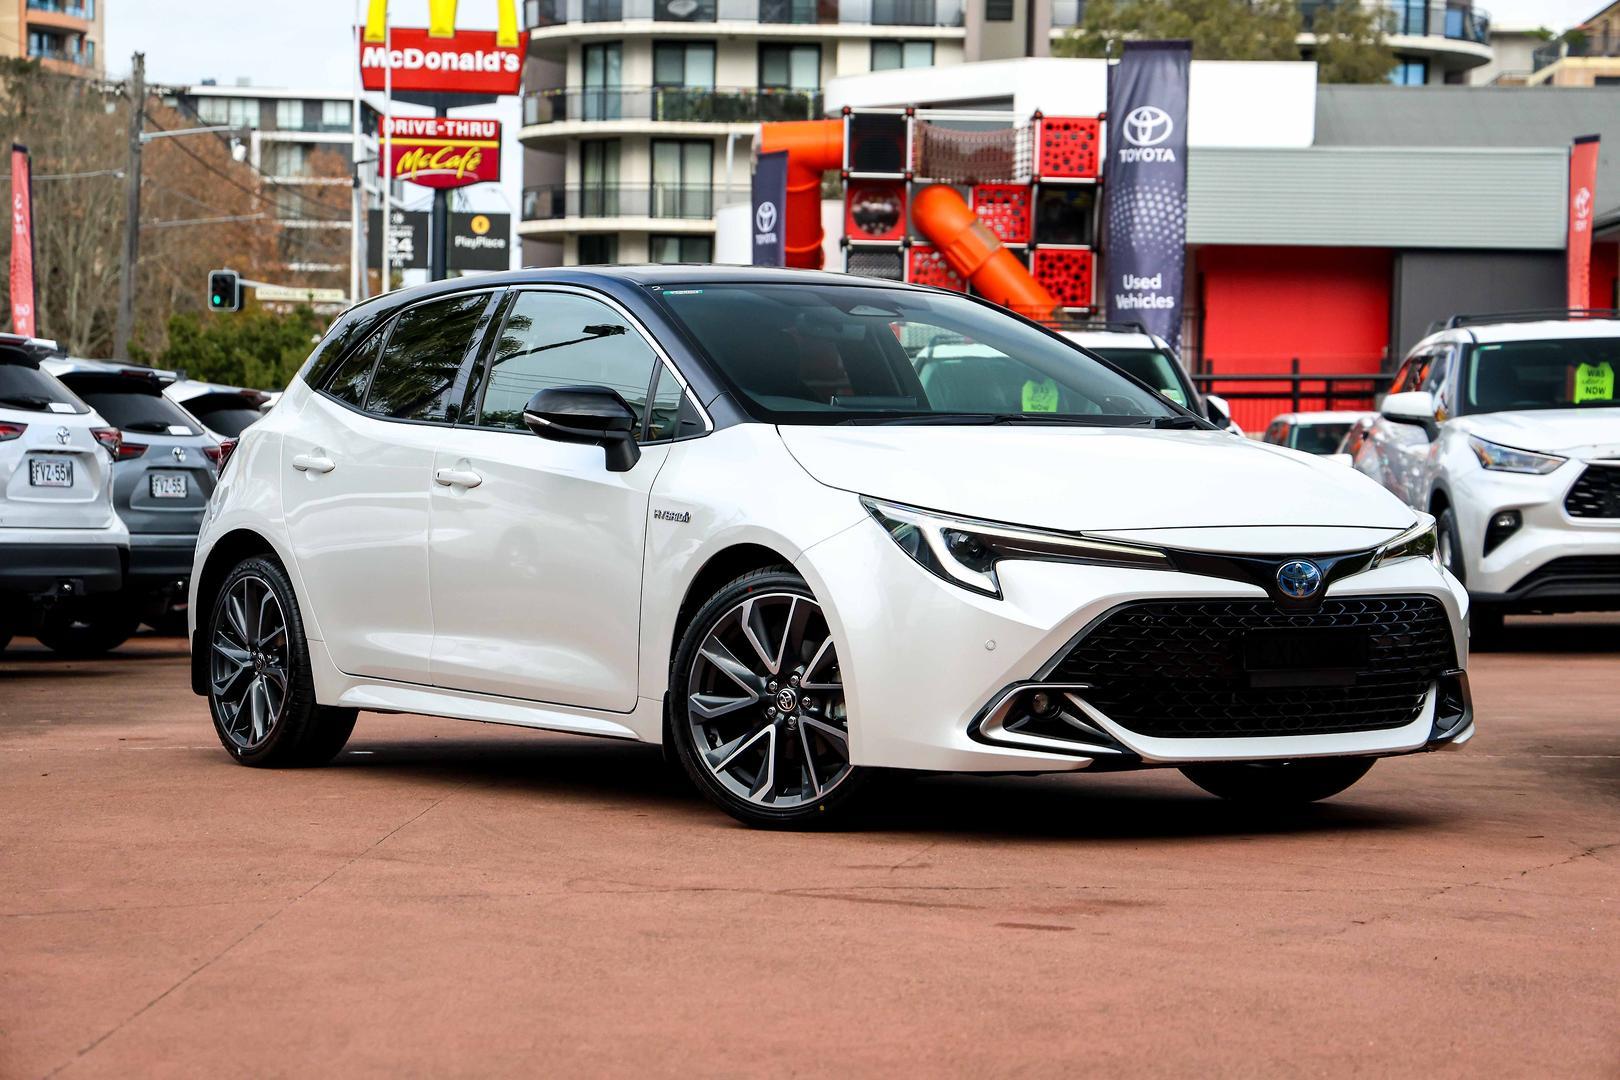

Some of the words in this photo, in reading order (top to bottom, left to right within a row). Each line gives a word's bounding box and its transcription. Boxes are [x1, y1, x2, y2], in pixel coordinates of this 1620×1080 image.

[361, 46, 520, 72] McDonald's
[1119, 147, 1176, 163] TOYOTA
[454, 235, 506, 250] PlayPlace
[1122, 272, 1162, 290] Used
[1115, 292, 1175, 310] Vehicles
[1585, 386, 1607, 395] NOW
